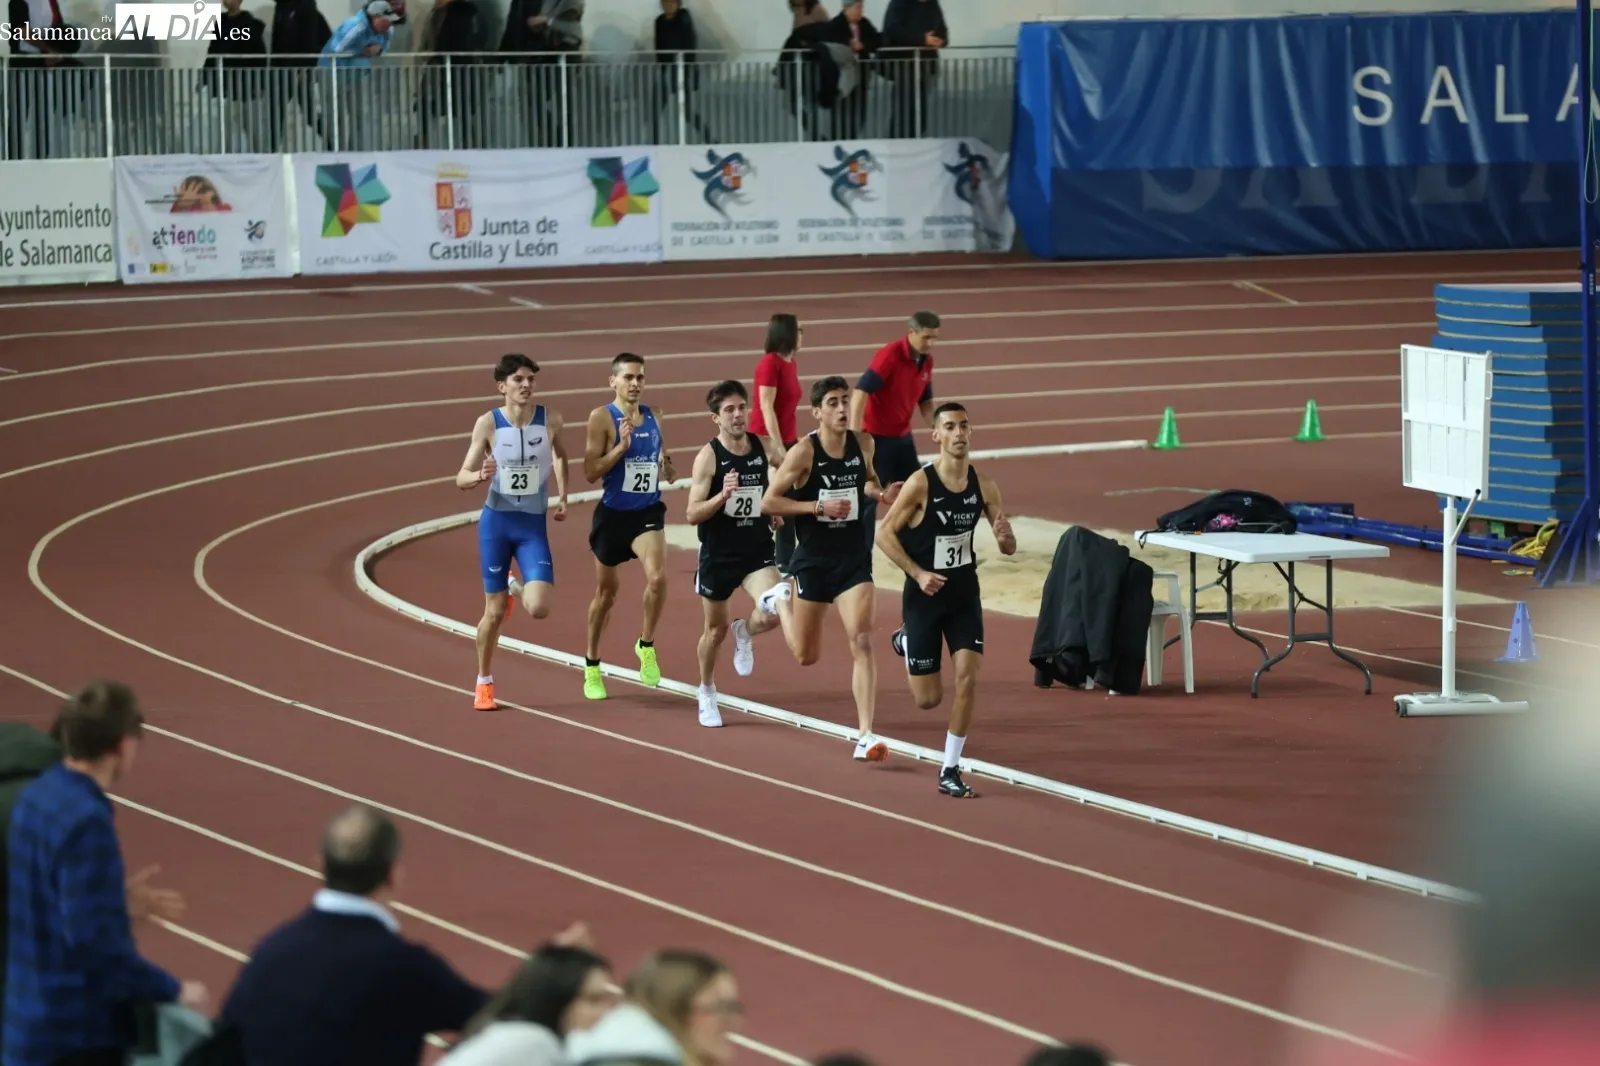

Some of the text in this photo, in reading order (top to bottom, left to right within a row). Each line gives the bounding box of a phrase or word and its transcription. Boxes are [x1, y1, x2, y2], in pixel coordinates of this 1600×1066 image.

[152, 224, 217, 247] atiendo
[480, 216, 559, 236] Junta de
[20, 238, 112, 267] Salamanca
[429, 238, 558, 264] Castilla y León
[511, 473, 528, 490] 23
[632, 472, 650, 492] 25
[734, 497, 753, 516] 28
[953, 512, 976, 520] VICKY
[945, 545, 963, 567] 31
